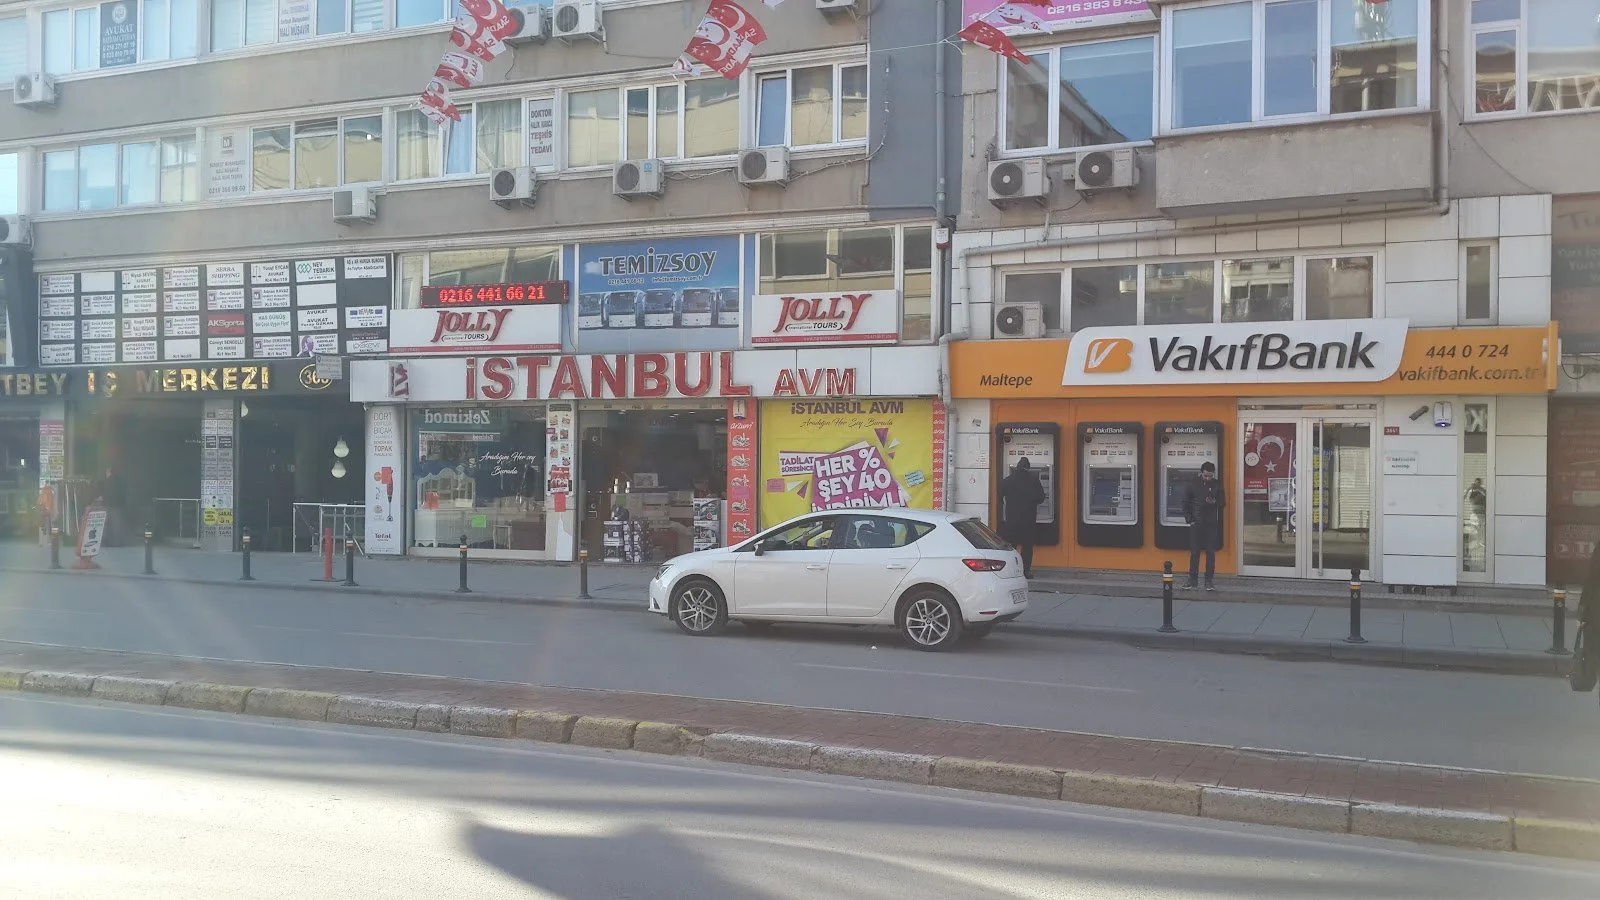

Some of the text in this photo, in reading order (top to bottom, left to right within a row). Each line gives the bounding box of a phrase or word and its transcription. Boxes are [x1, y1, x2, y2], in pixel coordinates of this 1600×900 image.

[439, 285, 545, 303] 0216 441 66 21
[430, 309, 512, 343] JOLLY
[773, 293, 872, 333] JOLLY
[1426, 344, 1510, 359] 444 0 724
[772, 367, 857, 396] AVM
[979, 373, 1033, 388] Maltepe
[869, 401, 904, 414] AVM
[815, 446, 881, 478] HER %
[818, 473, 856, 503] ŞEY
[858, 468, 892, 492] 40
